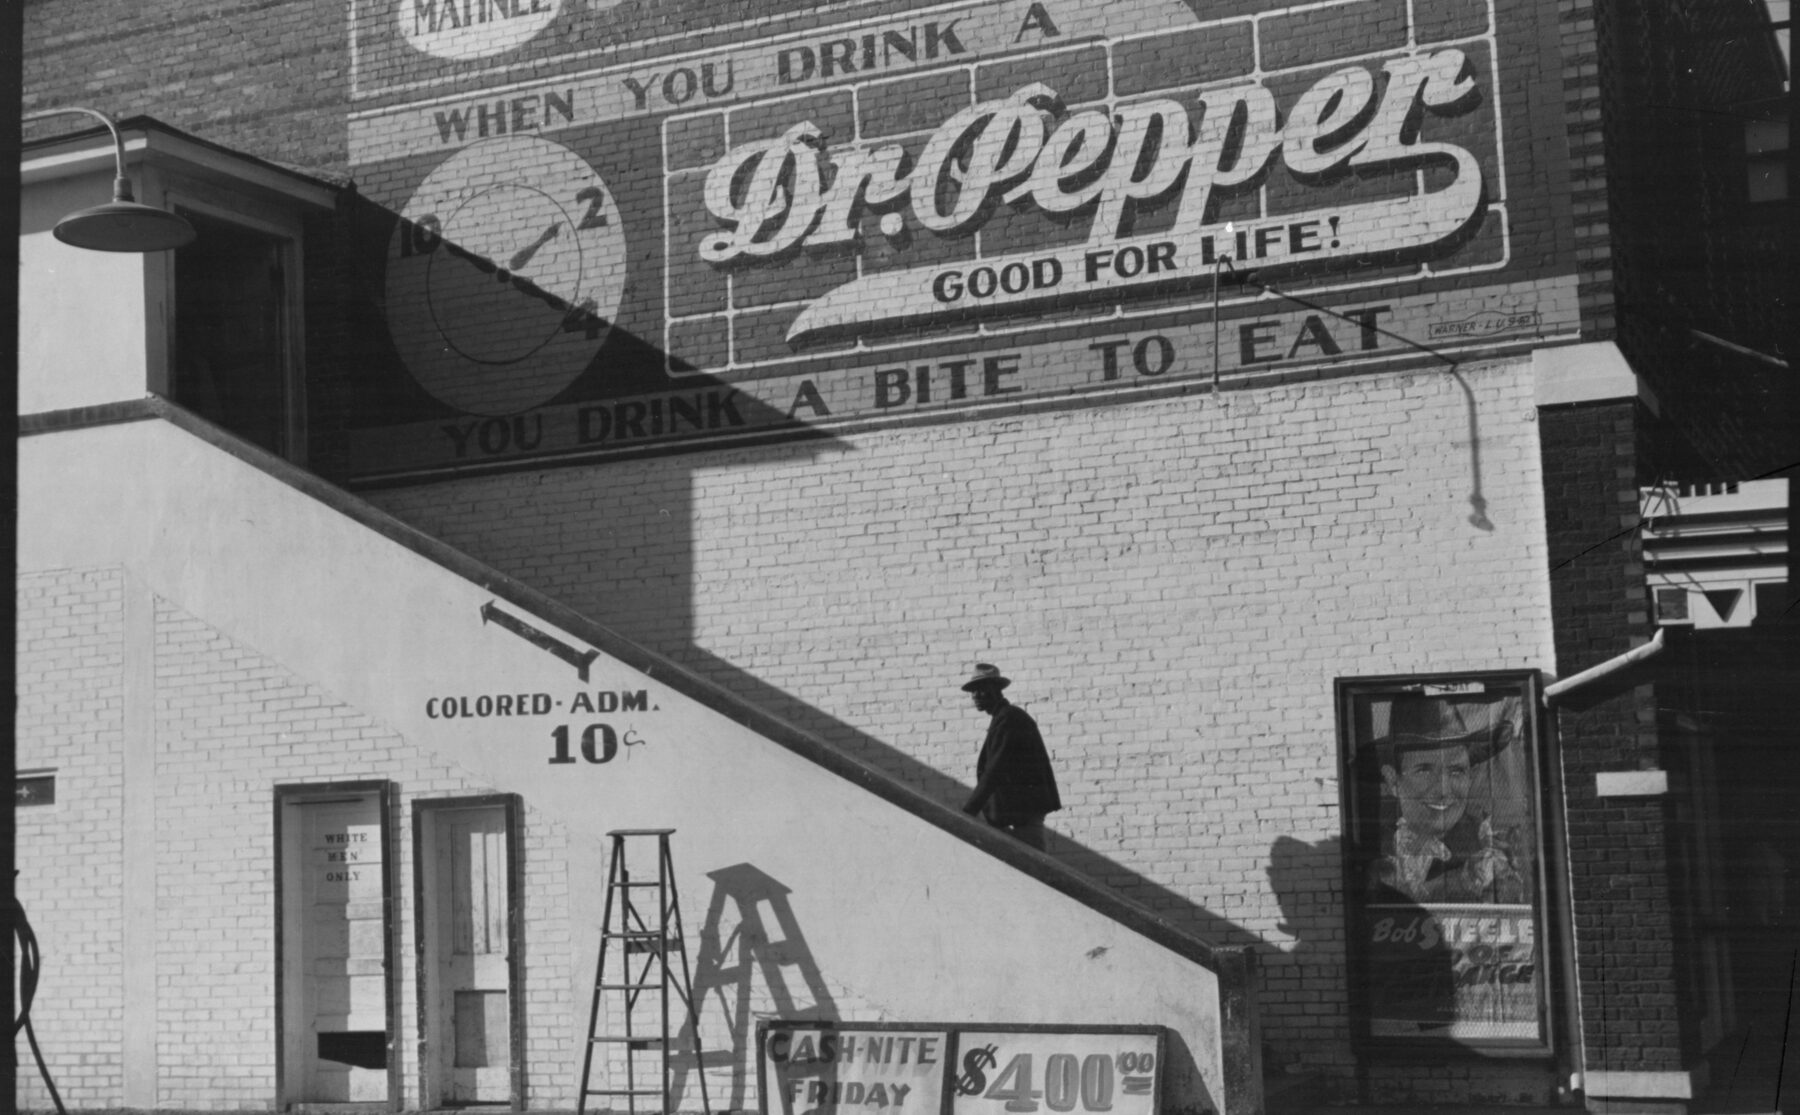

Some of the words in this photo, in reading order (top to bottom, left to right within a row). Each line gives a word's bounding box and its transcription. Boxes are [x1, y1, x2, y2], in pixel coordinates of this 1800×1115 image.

[434, 89, 574, 144] WHEN
[622, 60, 735, 110] YOU
[777, 17, 967, 85] DRINK
[1013, 1, 1062, 43] A
[576, 186, 609, 231] 2
[401, 213, 442, 258] 10
[932, 256, 1063, 303] GOOD
[1084, 241, 1178, 283] FOR
[1201, 215, 1341, 266] LIFE!
[441, 413, 542, 458] YOU
[578, 388, 748, 445] DRINK
[786, 378, 832, 419] A
[873, 354, 1022, 409] BITE
[1090, 334, 1176, 382] TO
[1238, 304, 1393, 365] EAT
[569, 689, 661, 714] ADM.
[324, 832, 368, 844] WHITE
[327, 851, 358, 863] MEN
[326, 871, 361, 882] ONLY
[1372, 917, 1421, 943] Bob
[1417, 916, 1535, 950] STEELE
[787, 1077, 912, 1109] FRIDAY
